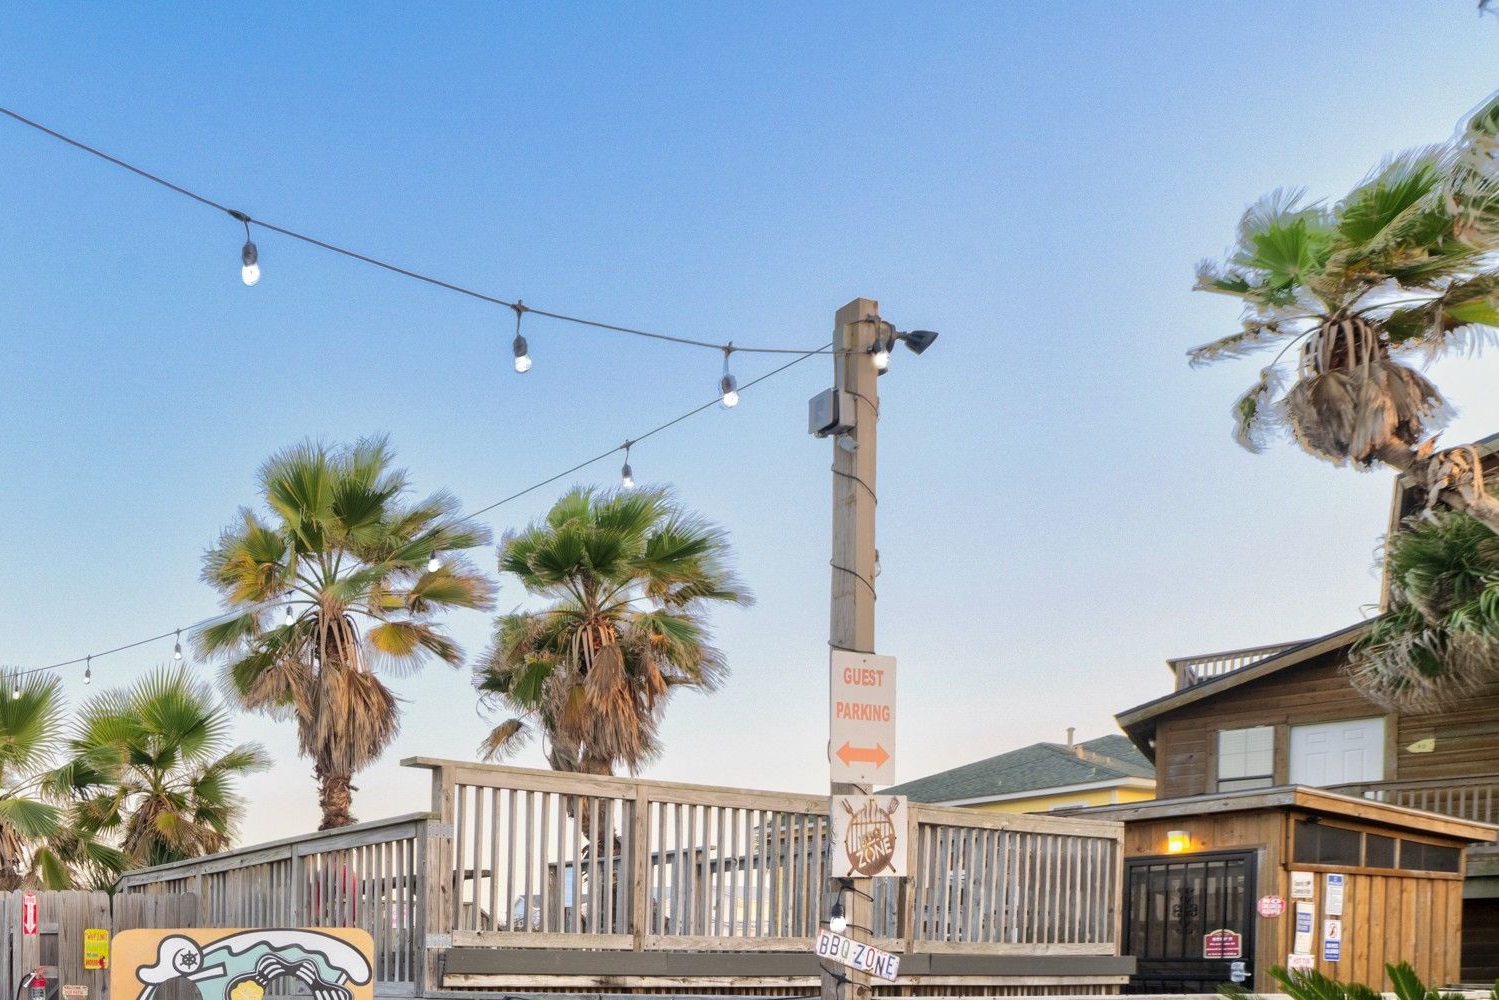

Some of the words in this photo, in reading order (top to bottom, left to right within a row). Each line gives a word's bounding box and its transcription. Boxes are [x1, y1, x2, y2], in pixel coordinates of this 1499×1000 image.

[843, 667, 885, 687] GUEST
[836, 701, 891, 722] PARKING
[855, 836, 892, 868] ZONE
[819, 934, 850, 960] BBQ
[854, 944, 895, 976] ZONE
